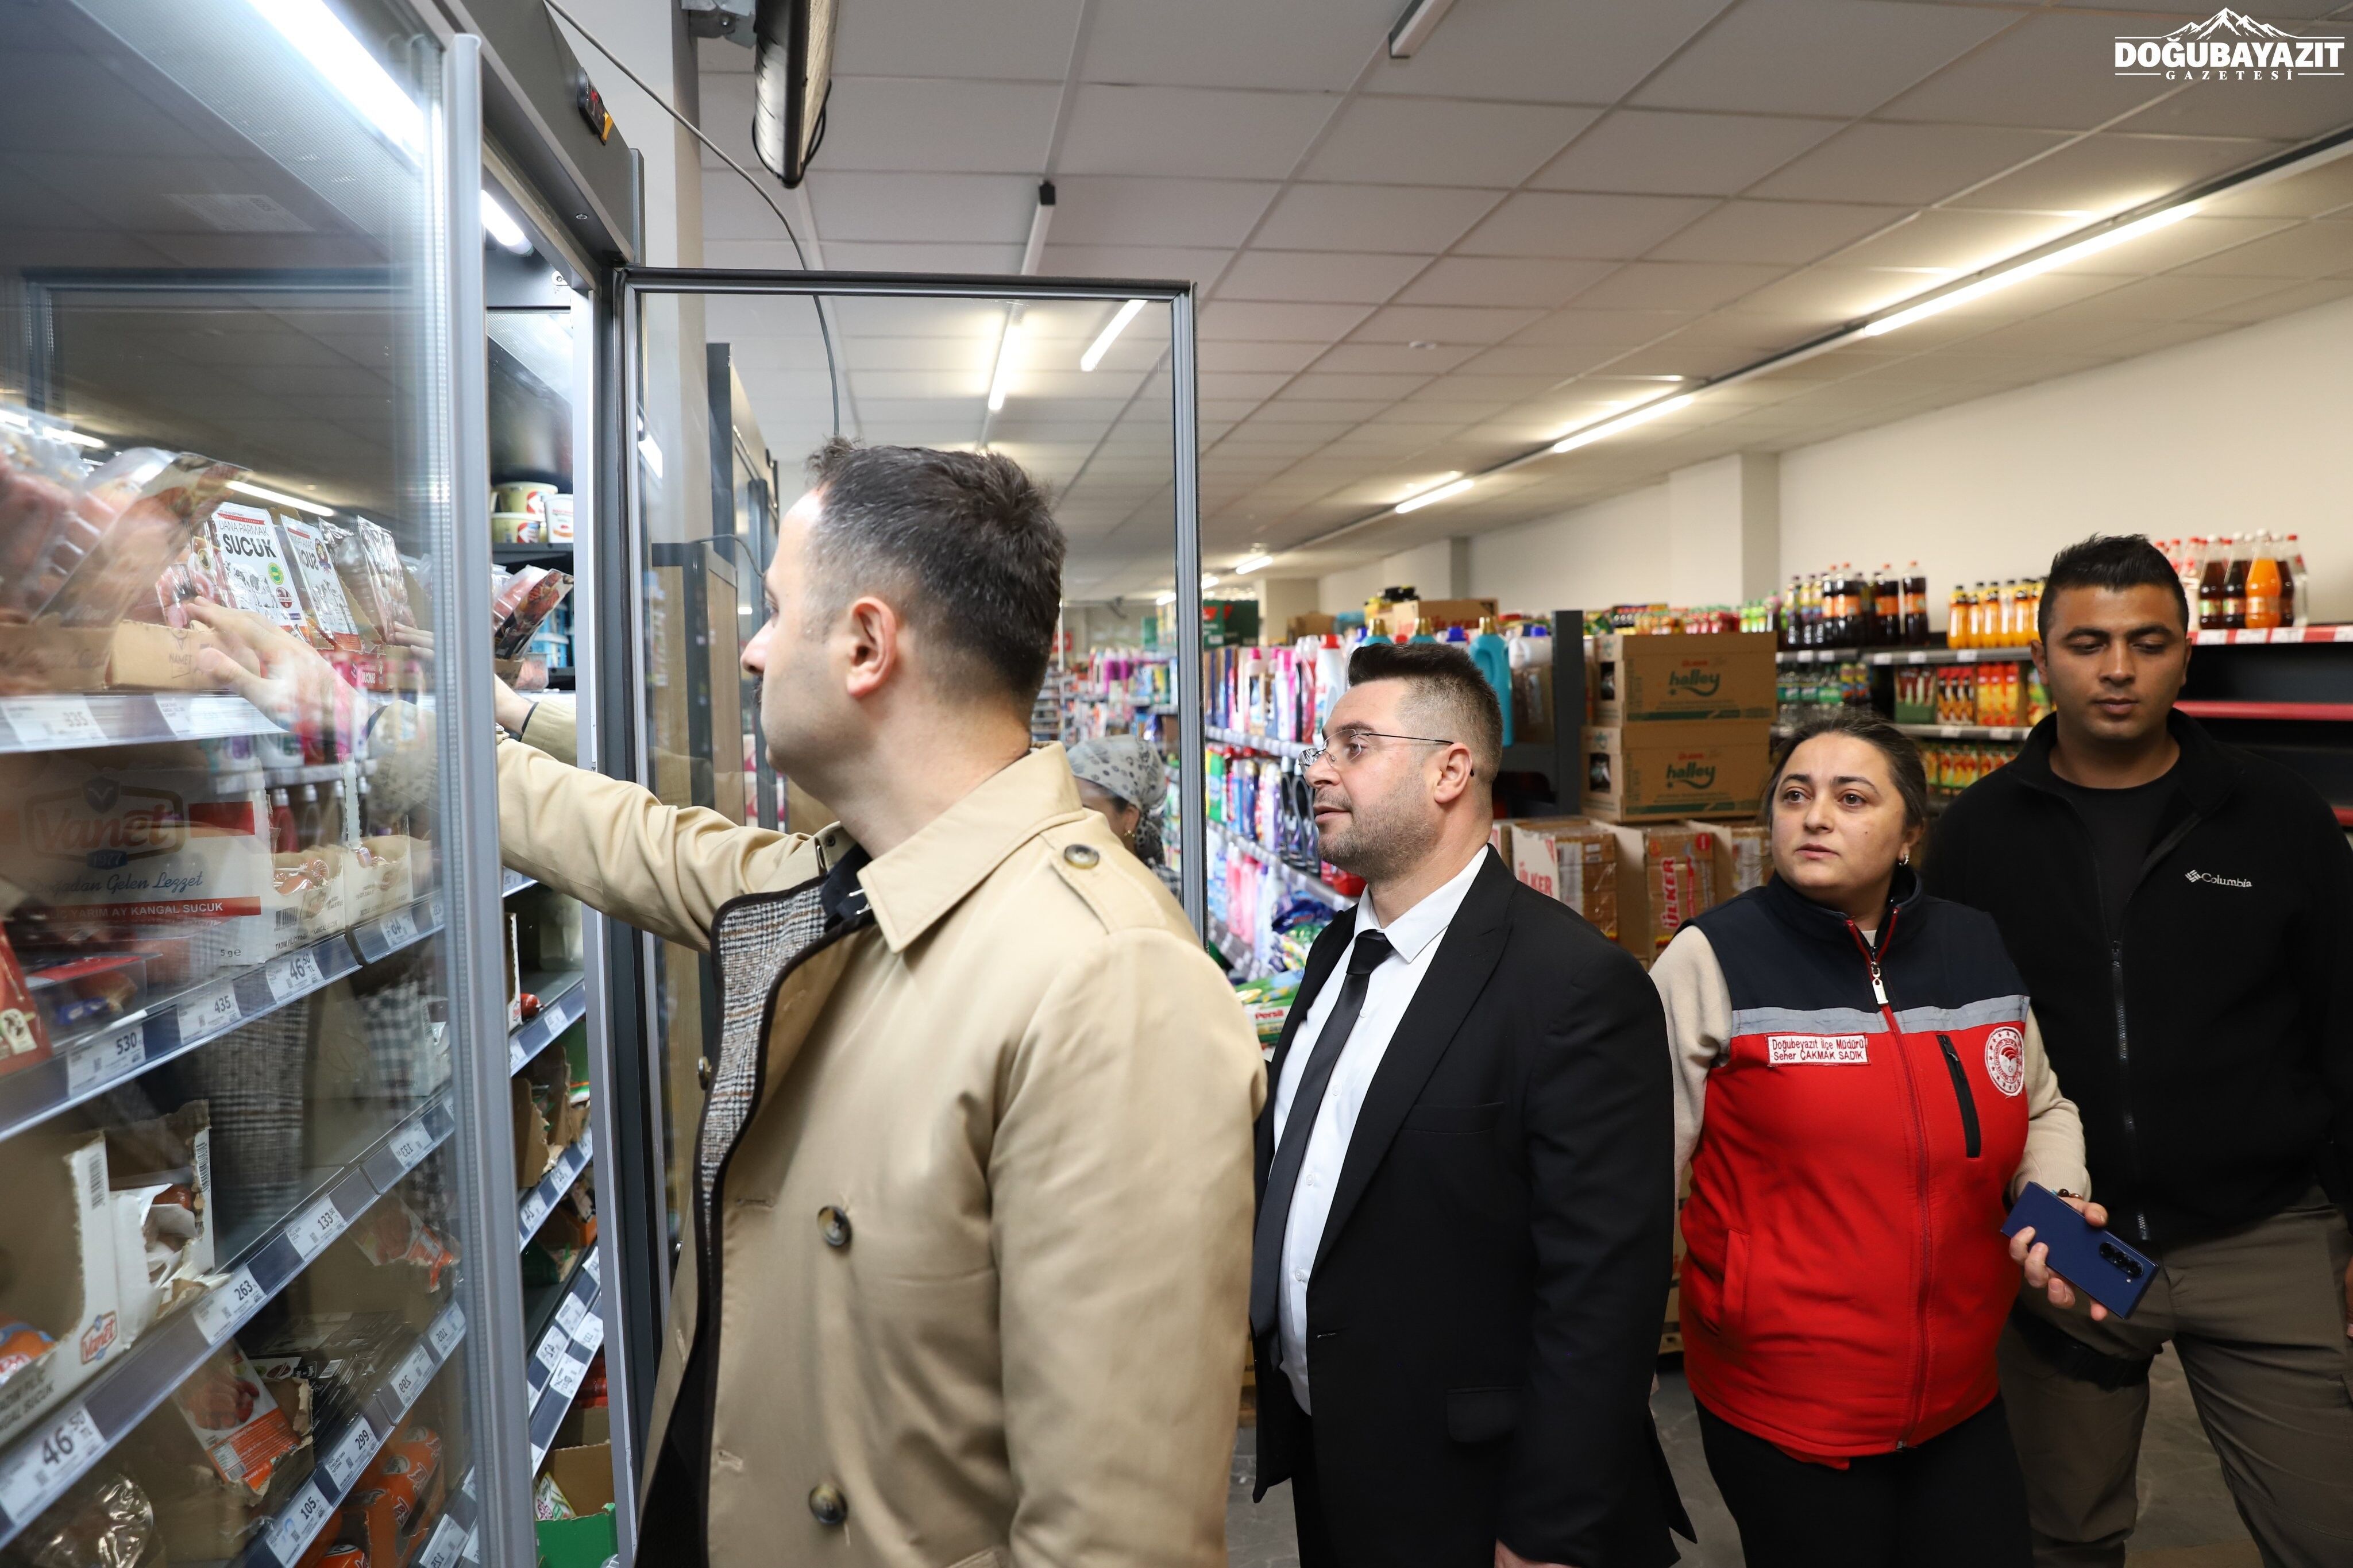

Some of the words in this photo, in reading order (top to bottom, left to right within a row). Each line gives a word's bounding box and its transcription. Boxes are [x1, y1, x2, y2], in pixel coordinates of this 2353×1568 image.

[219, 520, 238, 532] DANA
[239, 523, 269, 536] PARMAK
[223, 534, 277, 558] SUCUK
[1669, 669, 1721, 697] halley
[1667, 762, 1716, 789] halley
[93, 854, 122, 866] 1977
[107, 872, 149, 894] Gelen
[152, 870, 203, 893] Lezzet
[2201, 873, 2252, 887] Columbia
[1661, 858, 1680, 927] ÜLKER
[111, 907, 127, 917] AY
[131, 905, 180, 916] KANGAL
[183, 902, 223, 913] SUCUK
[214, 995, 230, 1013] 435
[1255, 1009, 1284, 1021] Persil
[116, 1032, 137, 1055] 530
[1774, 1052, 1796, 1061] Seher
[1800, 1051, 1835, 1061] ÇAKMAK
[1839, 1051, 1864, 1060] SADIK
[234, 1280, 253, 1301] 263
[355, 1430, 369, 1451] 299
[300, 1496, 317, 1520] 105
